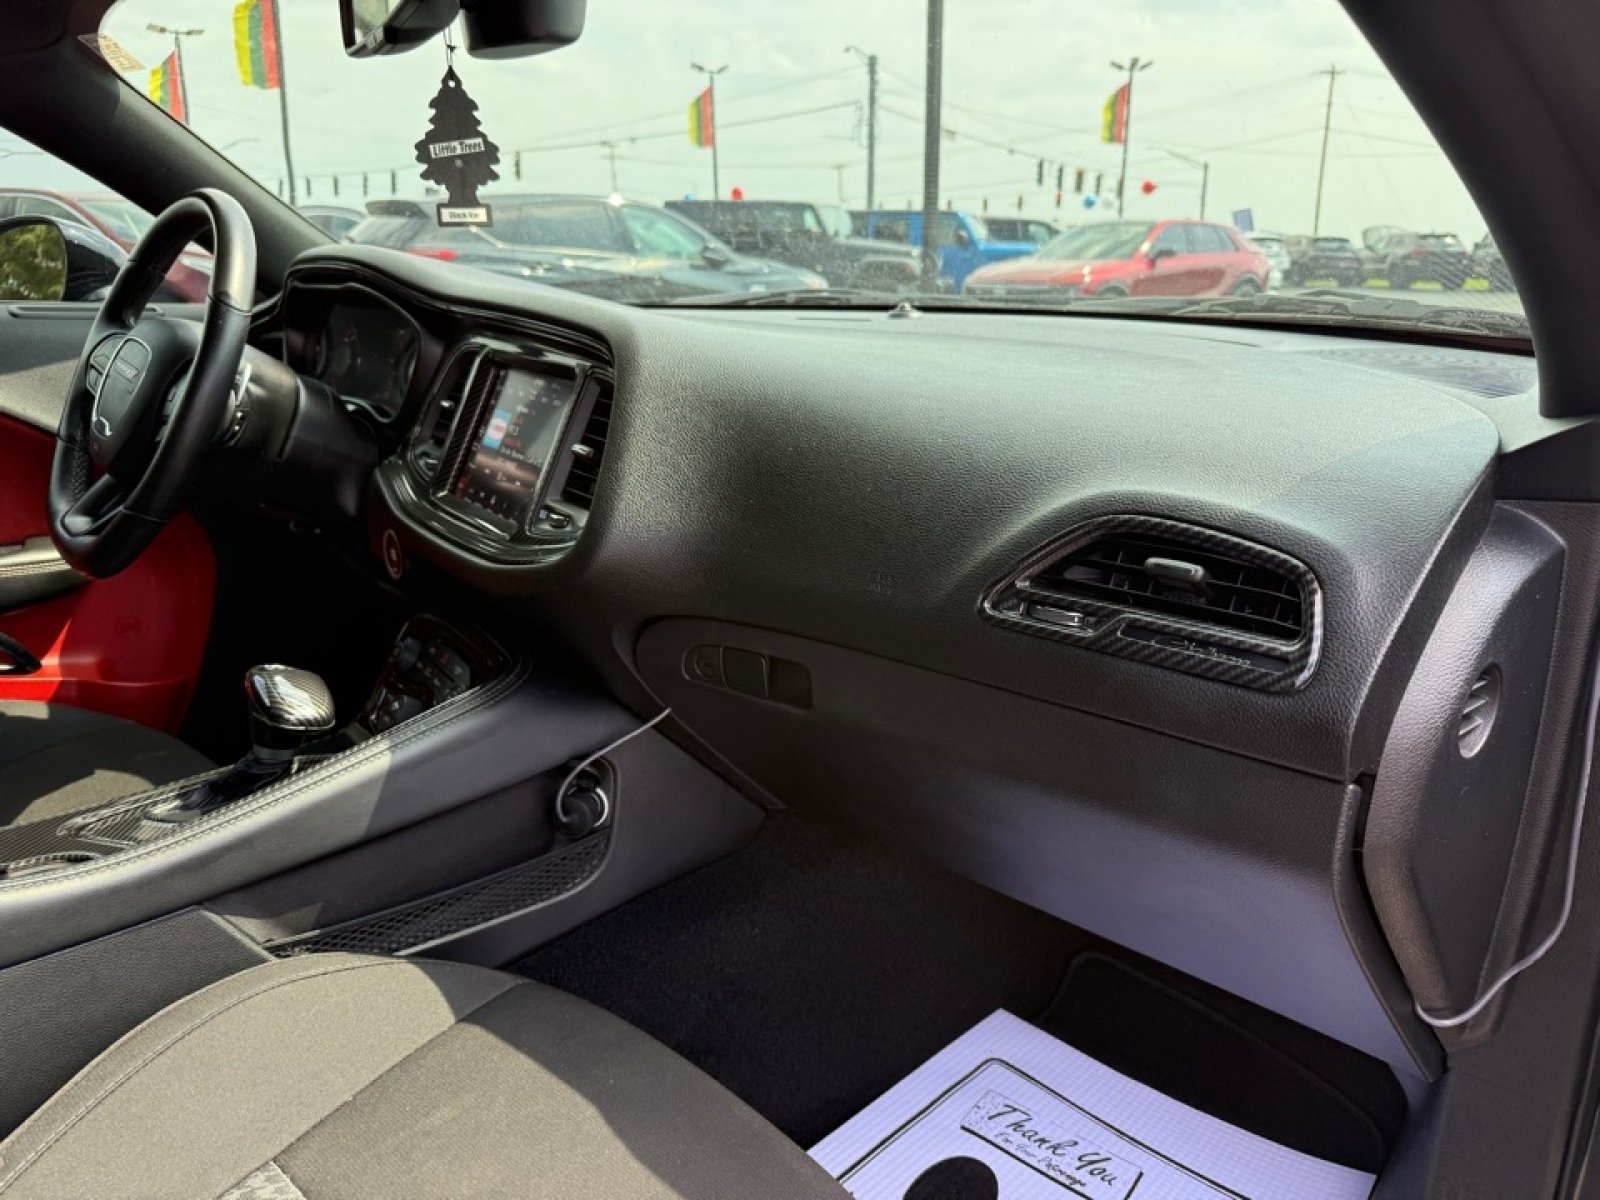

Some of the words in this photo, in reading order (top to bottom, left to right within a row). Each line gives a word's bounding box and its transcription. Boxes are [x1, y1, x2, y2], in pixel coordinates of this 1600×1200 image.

[433, 142, 457, 157] Little
[460, 140, 482, 152] Trees
[988, 1104, 1079, 1157] Thank
[1075, 1152, 1118, 1186] You
